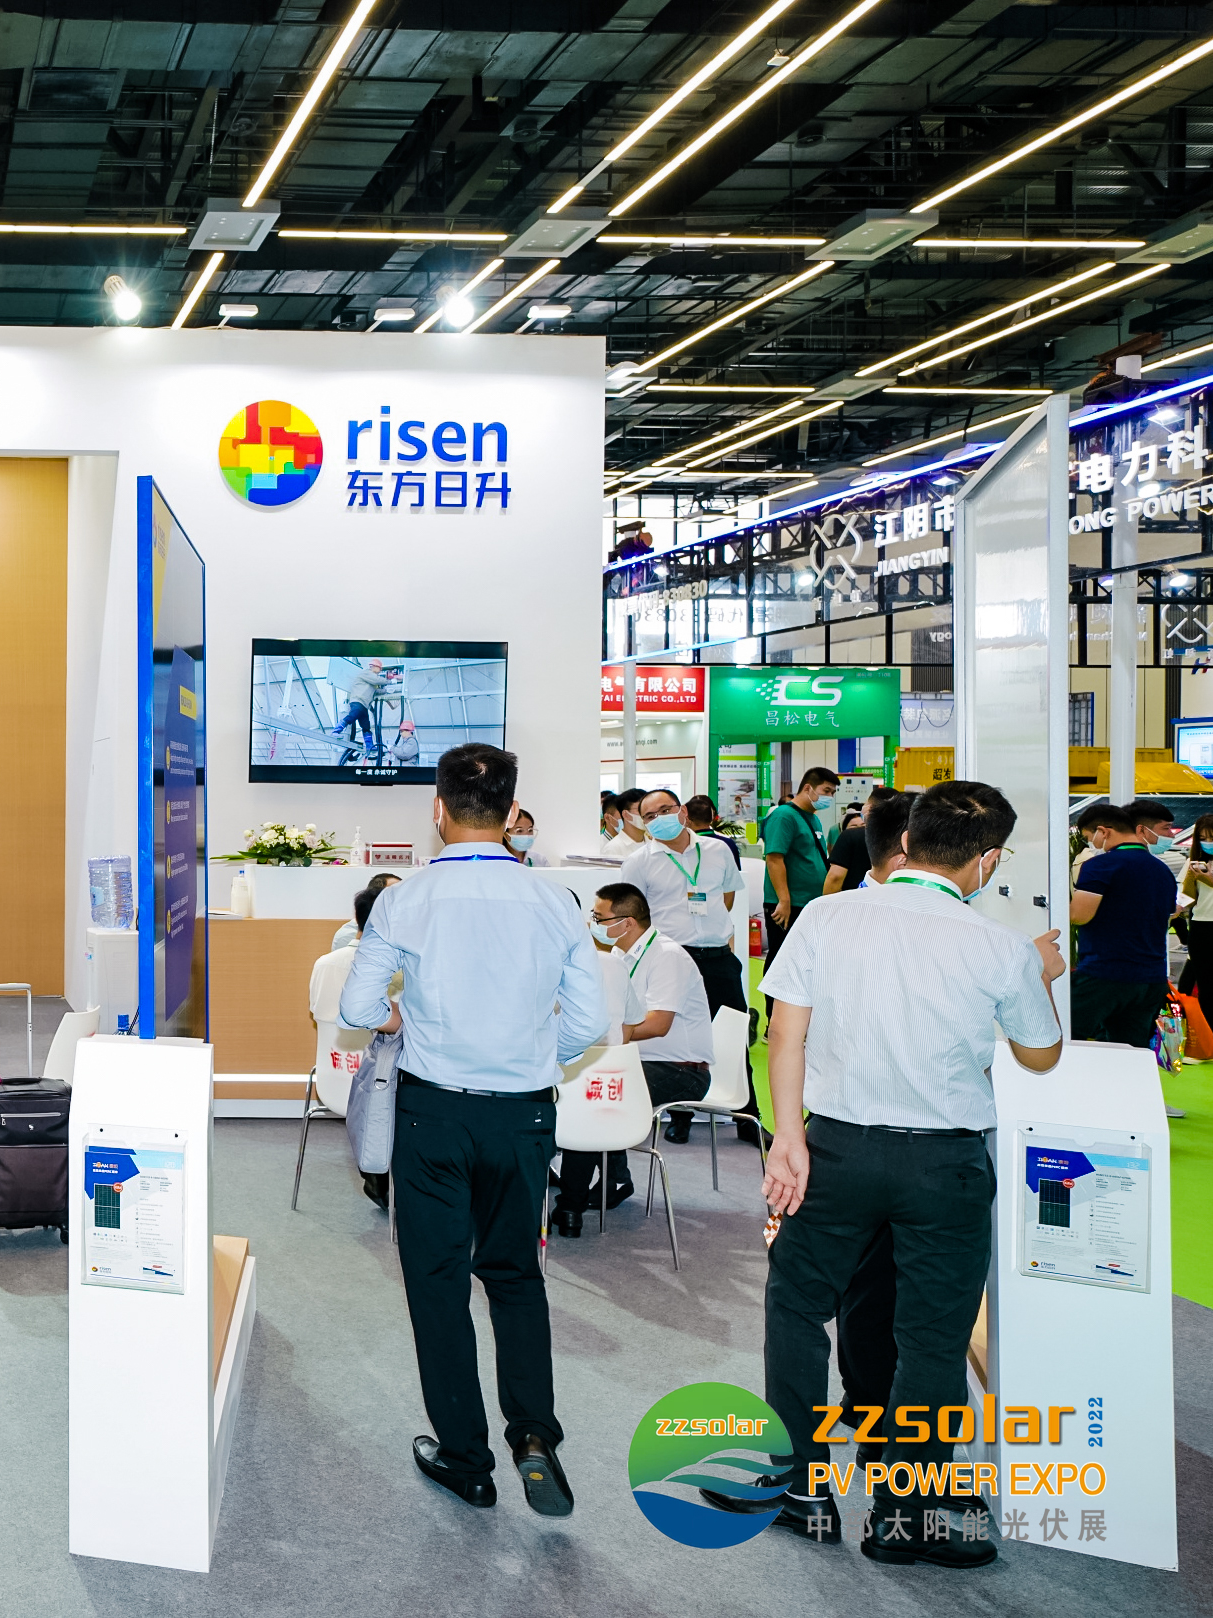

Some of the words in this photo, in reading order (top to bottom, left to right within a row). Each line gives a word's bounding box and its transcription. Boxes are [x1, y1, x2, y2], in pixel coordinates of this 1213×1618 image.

[347, 405, 508, 462] risen
[1069, 425, 1209, 499] 电力科
[346, 469, 512, 509] 东方日升
[874, 546, 950, 578] JIANGYIN
[765, 710, 840, 727] 昌松电气
